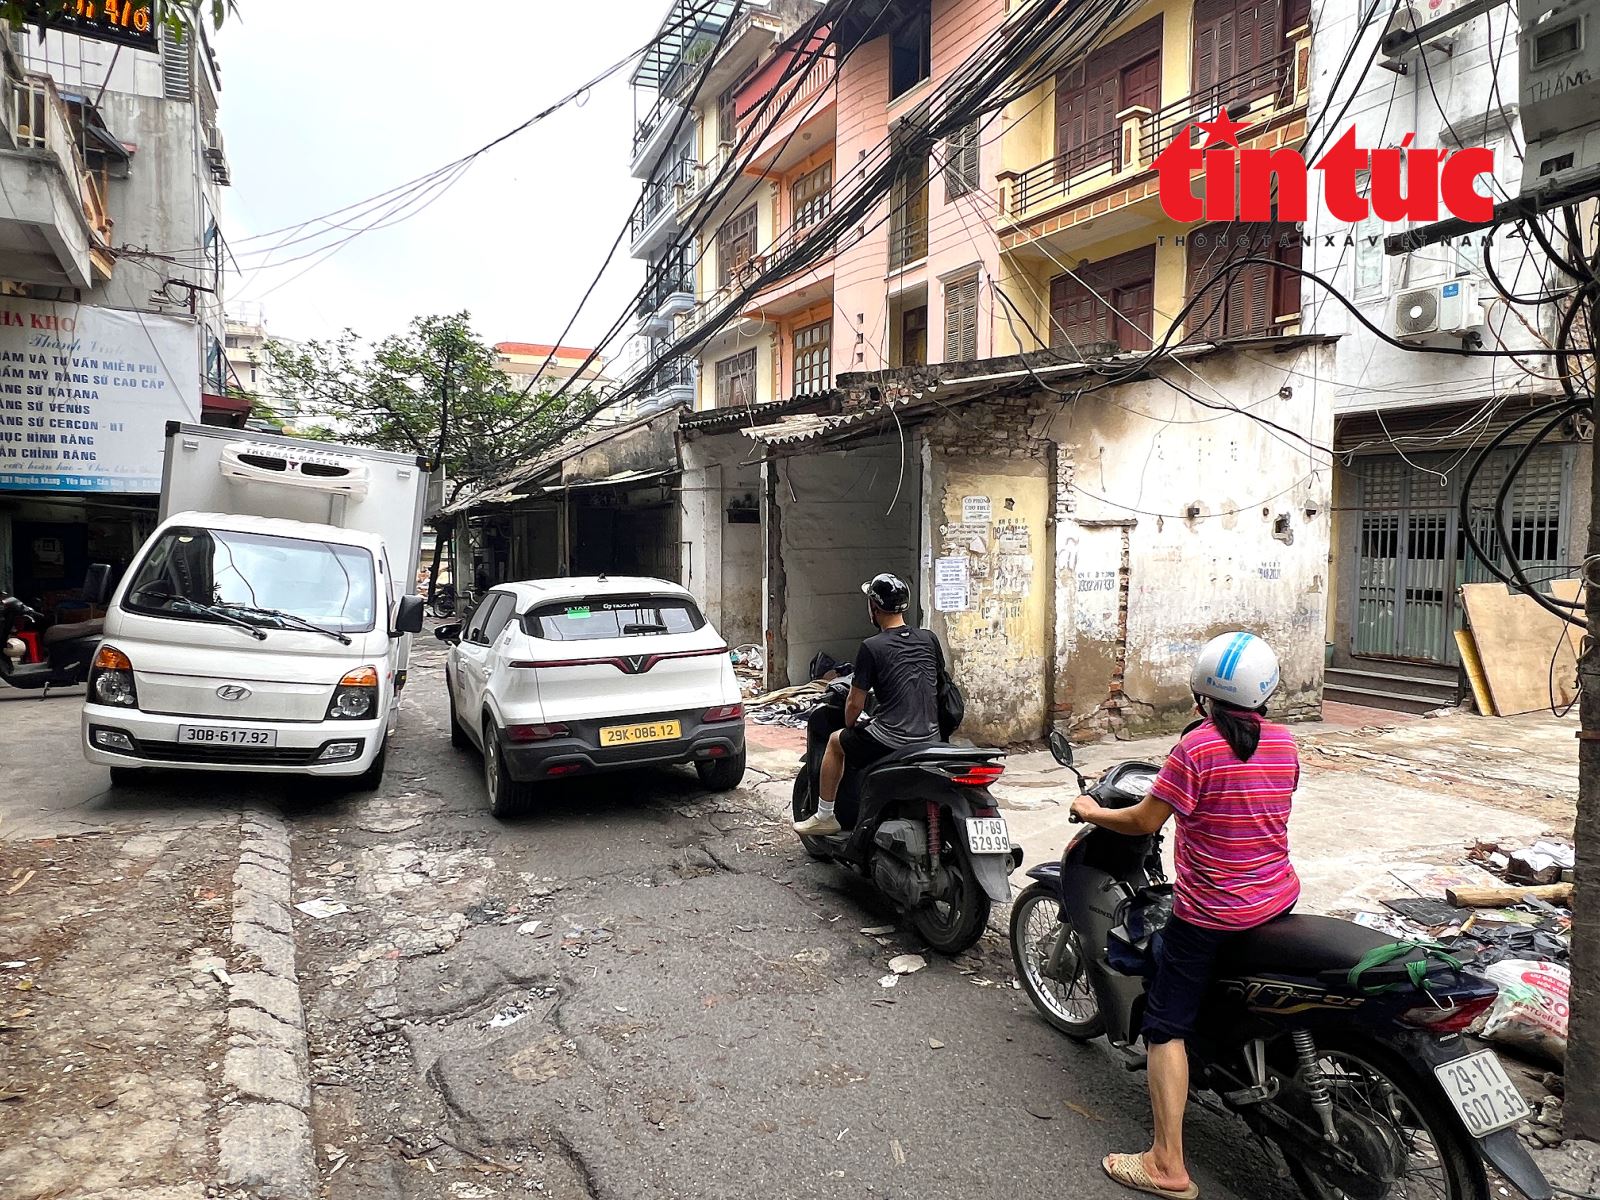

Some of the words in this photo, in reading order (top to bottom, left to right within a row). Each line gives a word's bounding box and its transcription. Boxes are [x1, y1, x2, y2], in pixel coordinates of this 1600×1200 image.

[113, 377, 137, 387] CAO
[48, 387, 99, 400] KATANA
[49, 403, 91, 415] VENUS
[49, 418, 99, 431] CERCON
[60, 433, 94, 445] RĂNG
[63, 449, 97, 461] RĂNG
[247, 448, 295, 460] THERMAL
[299, 455, 340, 467] MASTER
[186, 728, 269, 745] 30B-617.92
[607, 724, 674, 742] 29K-086.12
[971, 835, 1009, 851] 529.99
[1447, 1056, 1502, 1096] 29-Y1
[1461, 1084, 1525, 1131] 607.35
